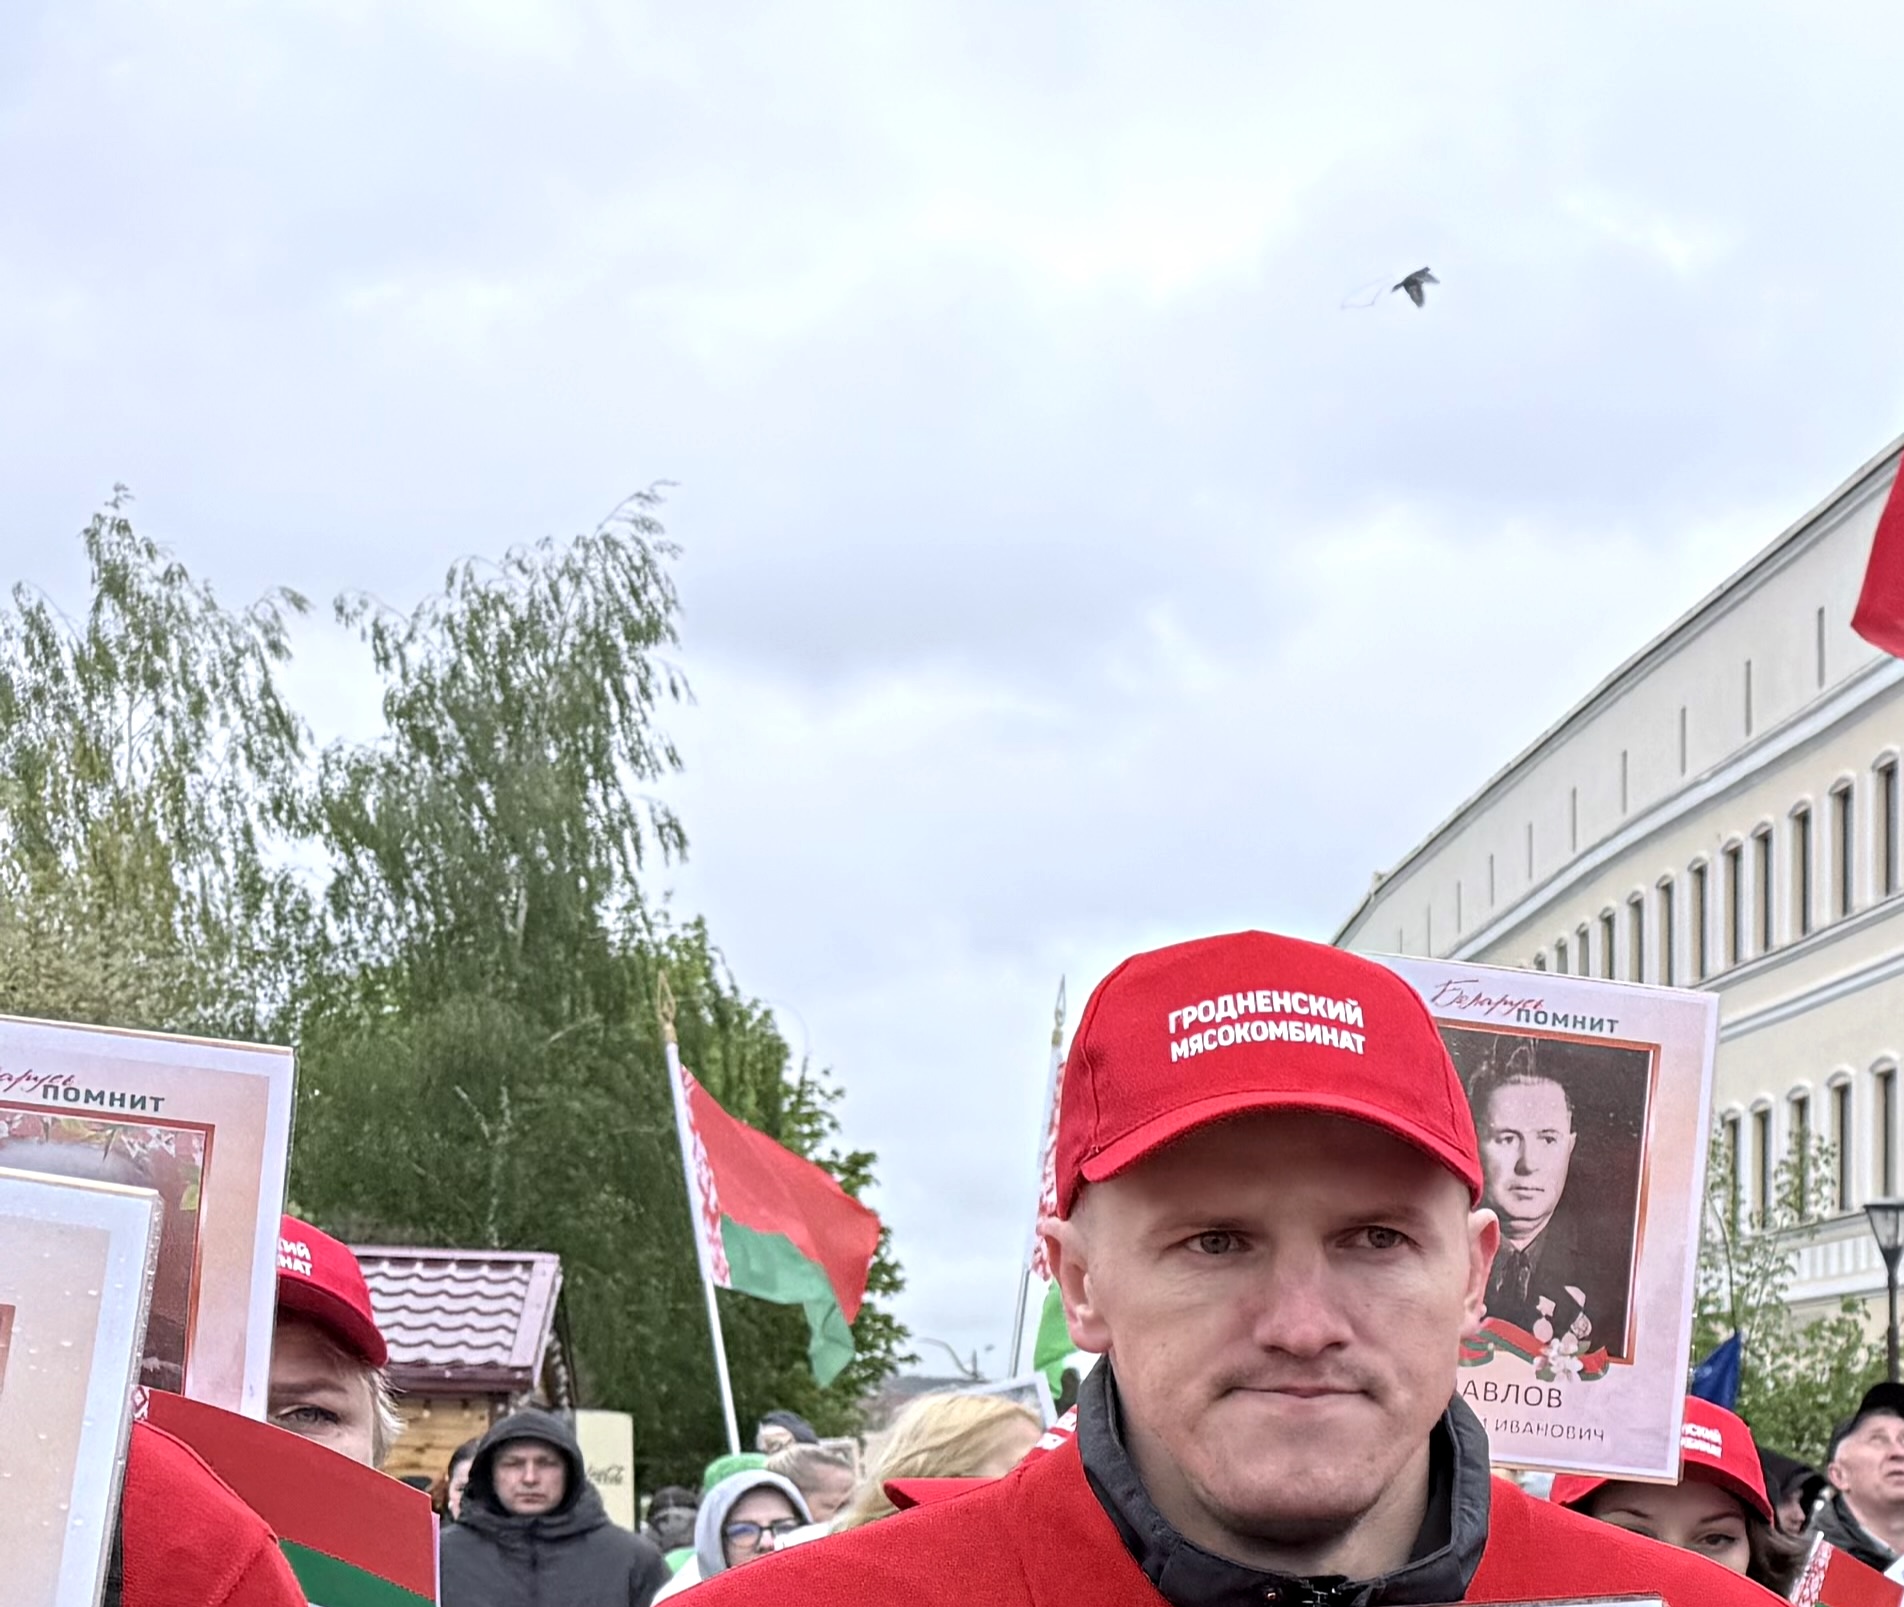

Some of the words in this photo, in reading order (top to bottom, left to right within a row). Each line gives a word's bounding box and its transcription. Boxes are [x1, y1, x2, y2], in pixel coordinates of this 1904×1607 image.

[1167, 989, 1365, 1035] ГРОДНЕНСКИЙ
[1515, 1007, 1620, 1035] ПОМНИТ
[1169, 1019, 1367, 1063] МЯСОКОМБИНАТ
[41, 1084, 165, 1113] ПОМНИТ
[1461, 1379, 1564, 1409] АВЛОВ
[1494, 1417, 1606, 1443] ИВАНОВИЧ
